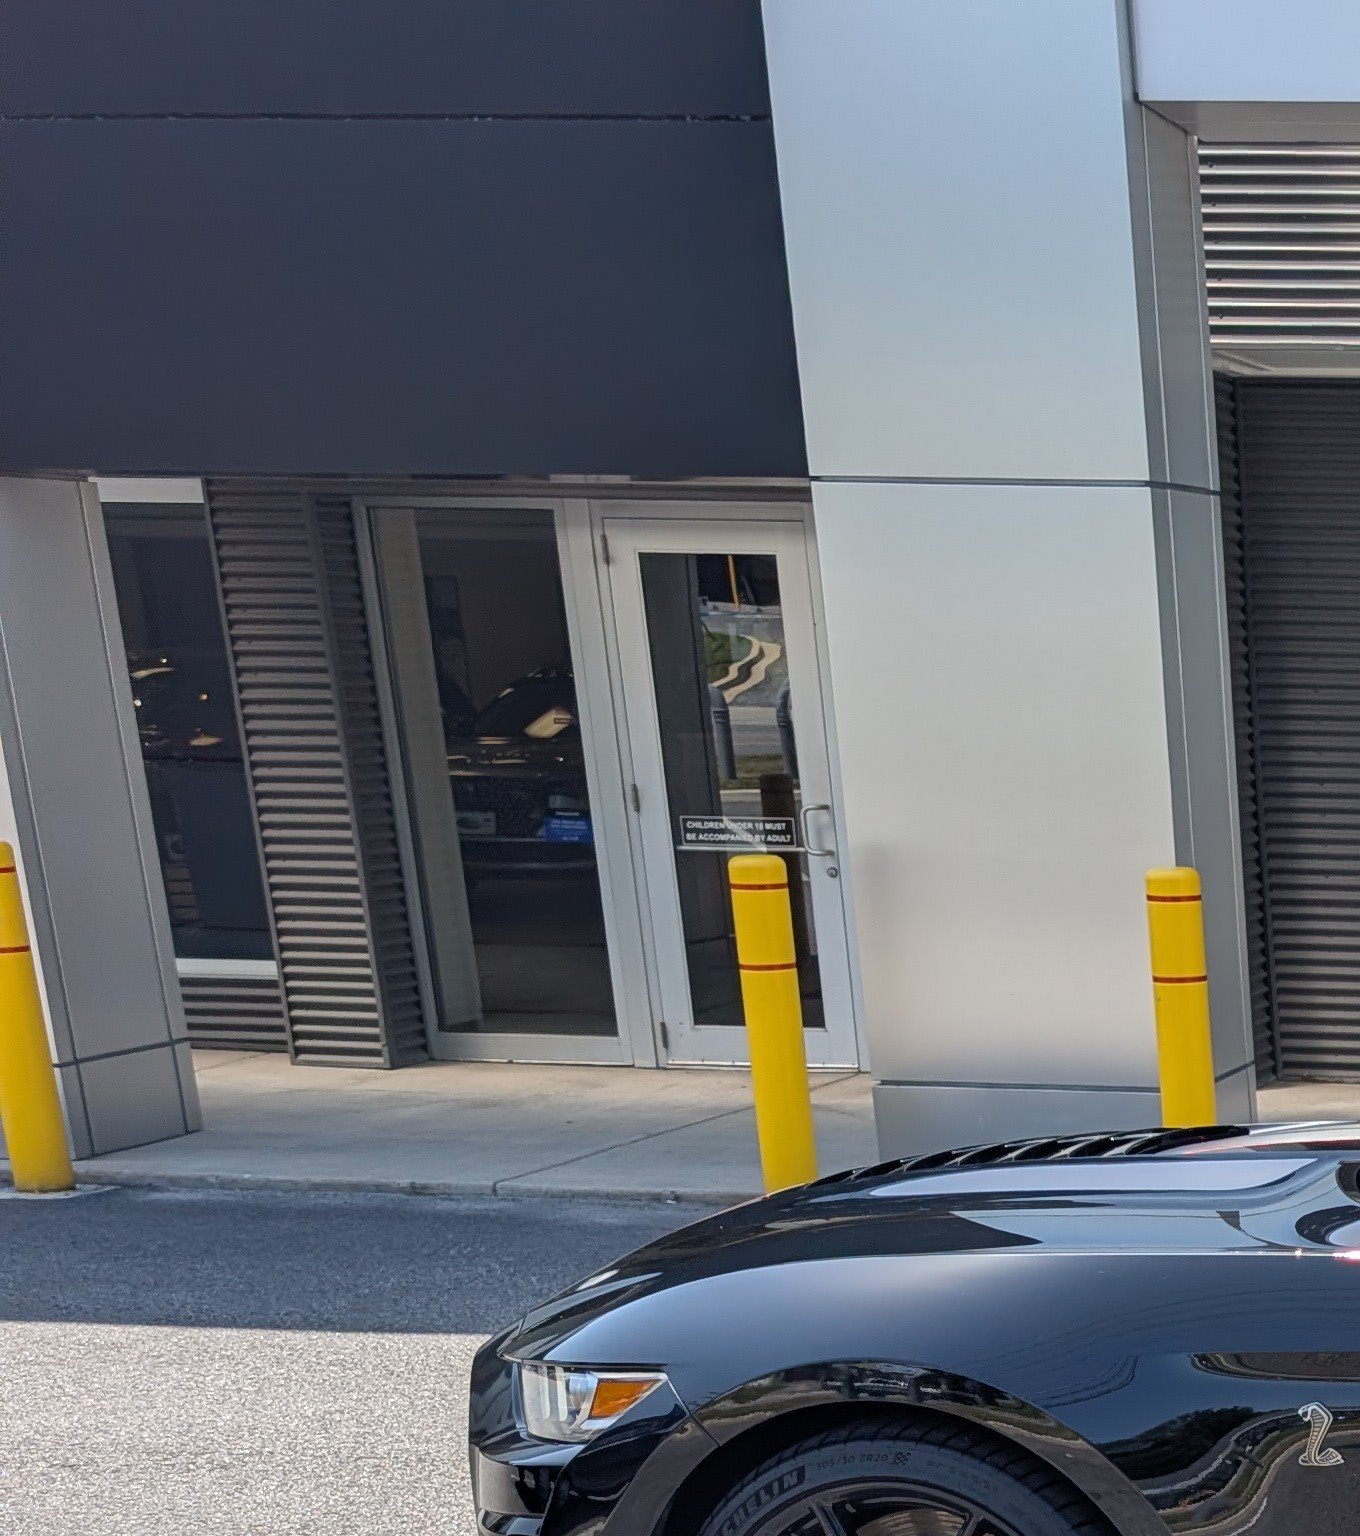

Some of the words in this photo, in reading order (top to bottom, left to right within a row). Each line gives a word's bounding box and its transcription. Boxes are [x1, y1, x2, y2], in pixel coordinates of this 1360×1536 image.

[686, 821, 725, 829] CHILDREN
[726, 822, 753, 830] UNDER
[765, 822, 786, 830] MUST
[686, 832, 696, 840] BE
[698, 832, 753, 842] ACCOMPANIED
[767, 834, 791, 842] ADULT
